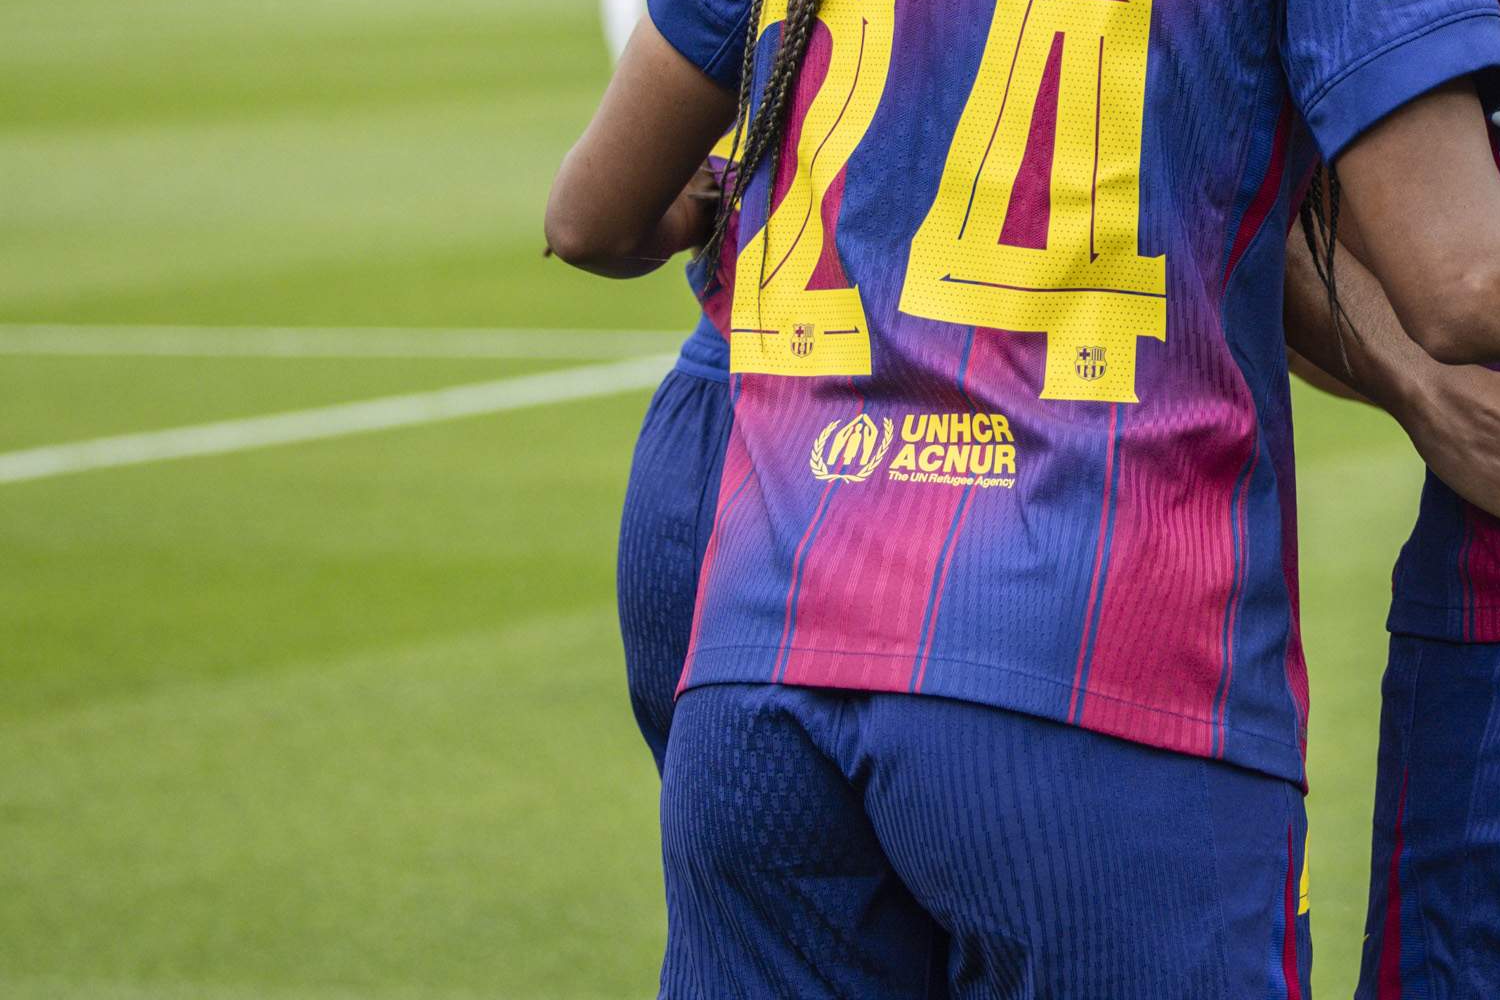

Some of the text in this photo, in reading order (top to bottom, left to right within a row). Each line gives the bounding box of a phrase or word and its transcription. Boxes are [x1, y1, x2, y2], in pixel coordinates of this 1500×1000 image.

[901, 413, 1014, 443] UNHCR
[889, 444, 1016, 474] ACNUR
[888, 471, 1015, 489] The UN Refugee Agency
